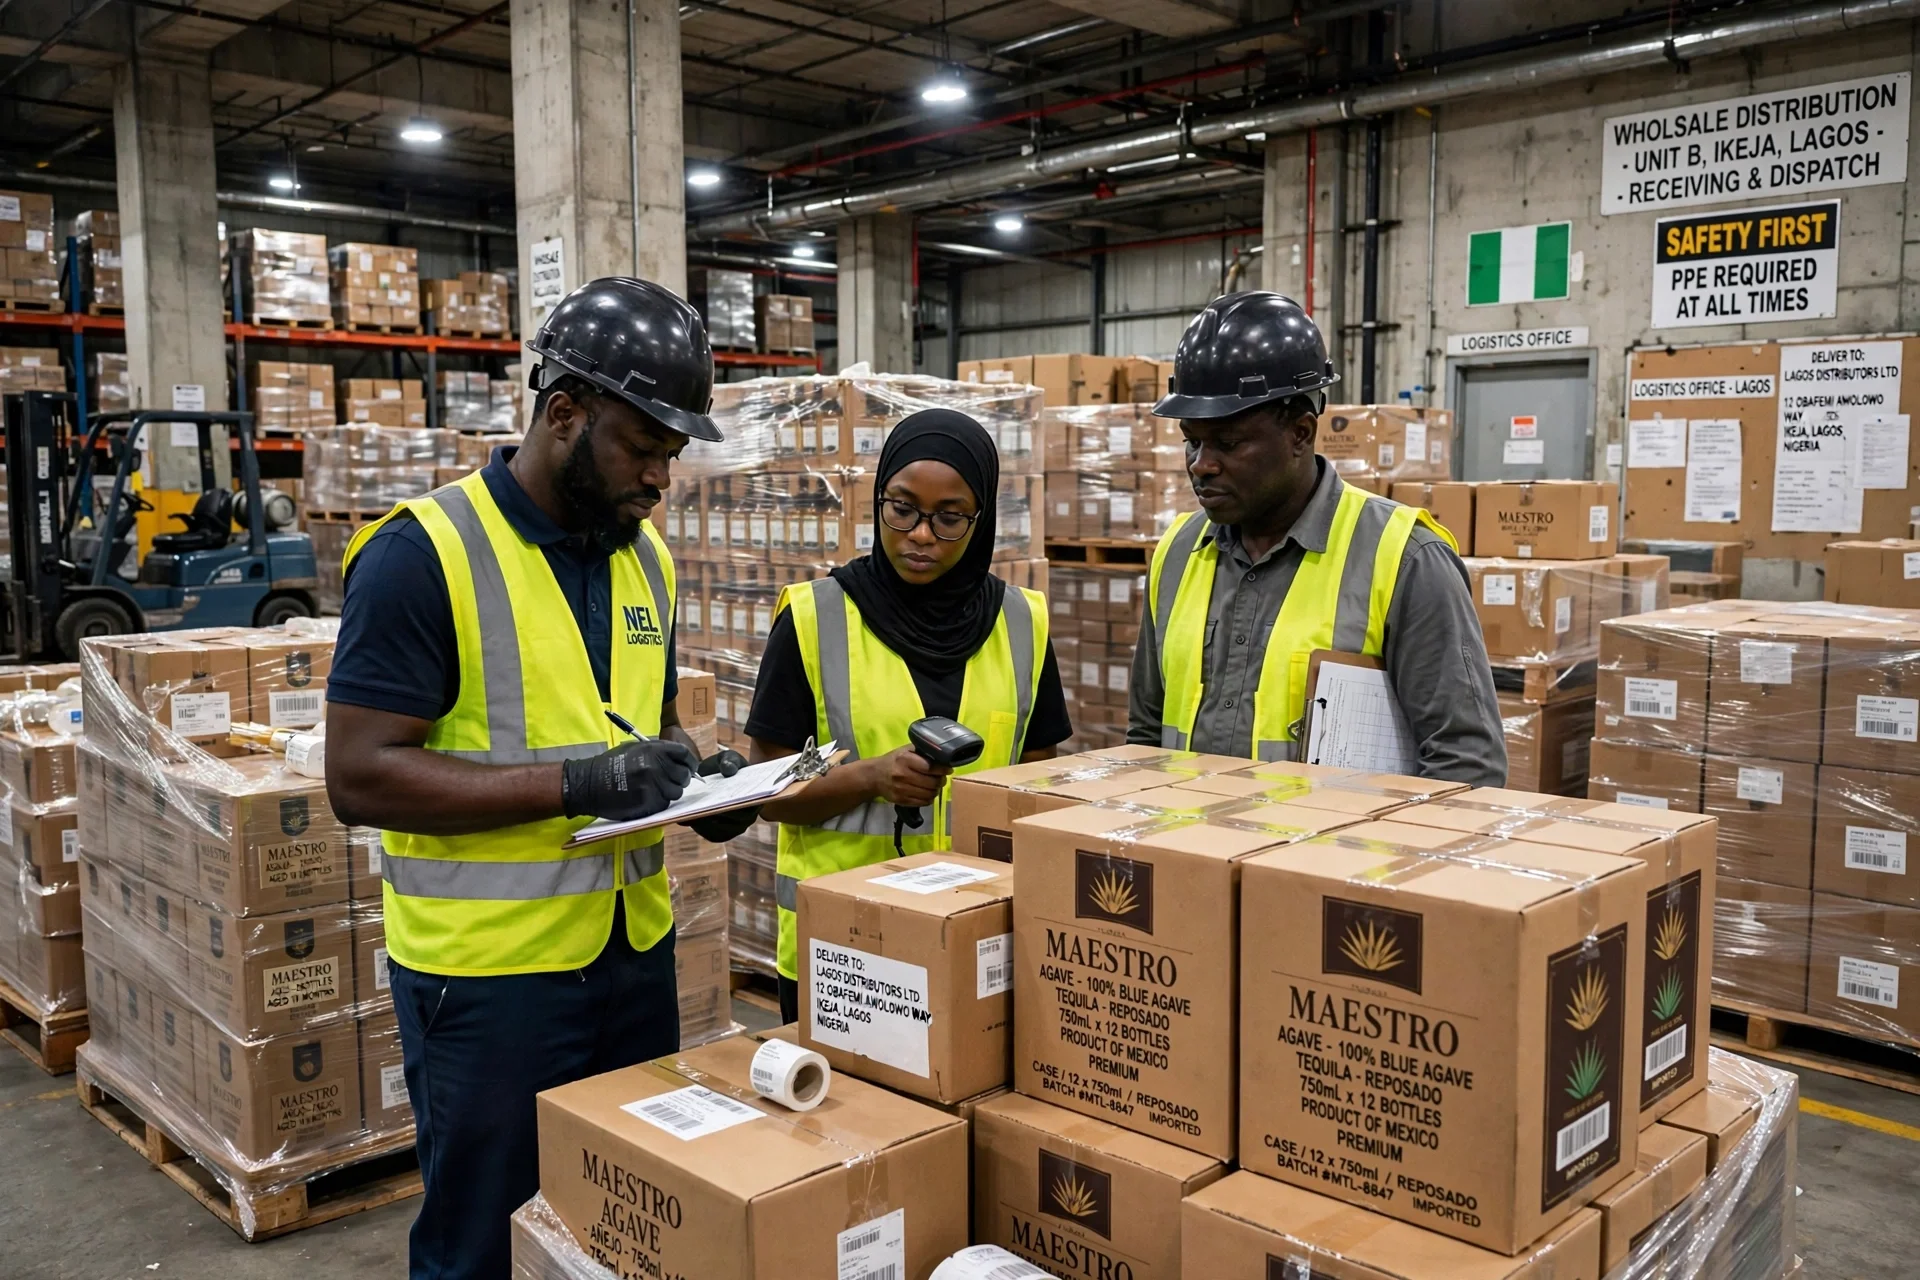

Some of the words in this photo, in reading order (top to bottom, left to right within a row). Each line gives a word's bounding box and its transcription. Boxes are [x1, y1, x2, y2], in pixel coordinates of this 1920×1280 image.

[1614, 108, 1728, 146] WHOLSALE
[1736, 83, 1897, 129] DISTRIBUTION
[1635, 147, 1681, 173] UNIT
[1687, 145, 1707, 168] B,
[1714, 133, 1782, 163] IKEJA,
[1790, 120, 1869, 153] LAGOS
[1629, 170, 1740, 204] RECEIVING
[1747, 167, 1762, 190] &
[1770, 152, 1880, 187] DISPATCH
[1666, 221, 1753, 257] SAFETY
[1758, 213, 1827, 248] FIRST
[1671, 267, 1708, 290] PPE
[1713, 257, 1817, 288] REQUIRED
[1676, 297, 1700, 318] AT
[1705, 293, 1741, 317] ALL
[1748, 287, 1809, 314] TIMES
[1462, 333, 1524, 351] LOGISTICS
[1527, 330, 1572, 346] OFFICE
[1812, 350, 1847, 363] DELIVER
[1850, 349, 1865, 361] TO:
[1634, 381, 1686, 397] LOGISTICS
[1689, 380, 1726, 395] OFFICE
[1735, 379, 1771, 394] LAGOS
[1784, 369, 1814, 381] LAGOS
[1881, 366, 1898, 378] LTD
[1498, 511, 1553, 524] MAESTRO
[622, 606, 658, 632] NEL
[627, 633, 663, 646] LOGISTICS
[268, 841, 327, 861] MAESTRO
[272, 963, 331, 986] MAESTRO
[816, 948, 849, 967] DELIVER
[851, 956, 865, 972] TO:
[1046, 928, 1177, 988] MAESTRO
[816, 965, 842, 982] LAGOS
[843, 972, 902, 998] DISTRIBUTORS
[1039, 964, 1074, 986] AGAVE
[1087, 976, 1115, 997] 100%
[1119, 983, 1149, 1006] BLUE
[1151, 992, 1191, 1016] AGAVE
[816, 982, 824, 994] 12
[911, 1006, 932, 1024] WAY
[843, 1005, 871, 1024] LAGOS
[1055, 986, 1099, 1012] TEQUILA
[1109, 1001, 1170, 1031] REPOSADO
[817, 1013, 850, 1034] NIGERIA
[1095, 1020, 1102, 1032] x
[1105, 1021, 1118, 1037] 12
[1121, 1024, 1170, 1051] BOTTLES
[1288, 985, 1460, 1058] MAESTRO
[1060, 1026, 1108, 1053] PRODUCT
[1110, 1041, 1124, 1057] OF
[1127, 1047, 1168, 1070] MEXICO
[1277, 1025, 1323, 1051] AGAVE
[1338, 1040, 1375, 1066] 100%
[1380, 1050, 1418, 1077] BLUE
[1422, 1061, 1473, 1090] AGAVE
[1089, 1054, 1139, 1082] PREMIUM
[1296, 1051, 1352, 1082] TEQUILA
[1365, 1070, 1442, 1105] REPOSADO
[280, 1084, 338, 1110] MAESTRO
[1032, 1060, 1059, 1079] CASE
[1061, 1069, 1065, 1081] /
[1068, 1072, 1080, 1085] 12
[1082, 1078, 1089, 1089] x
[1092, 1079, 1122, 1098] 750ml
[1127, 1090, 1133, 1101] /
[1137, 1092, 1199, 1122] REPOSADO
[1042, 1077, 1076, 1098] BATCH
[1149, 1111, 1202, 1137] IMPORTED
[1301, 1096, 1361, 1128] PRODUCT
[1364, 1114, 1382, 1133] OF
[1386, 1119, 1439, 1150] MEXICO
[1346, 1090, 1354, 1105] x
[1360, 1091, 1375, 1110] 12
[1380, 1096, 1442, 1128] BOTTLES
[1337, 1129, 1403, 1163] PREMIUM
[582, 1148, 682, 1230] MAESTRO
[1264, 1134, 1298, 1156] CASE
[1301, 1145, 1306, 1158] /
[1310, 1149, 1324, 1165] 12
[1327, 1156, 1335, 1167] x
[1339, 1157, 1378, 1181] 750ml
[1384, 1171, 1392, 1185] /
[1397, 1175, 1478, 1211] REPOSADO
[1277, 1153, 1318, 1178] BATCH
[1321, 1170, 1394, 1200] #MTL-8847
[601, 1197, 661, 1255] AGAVE
[1412, 1197, 1481, 1228] IMPORTED
[590, 1222, 622, 1255] AÑEJO
[1011, 1215, 1134, 1280] MAESTRO
